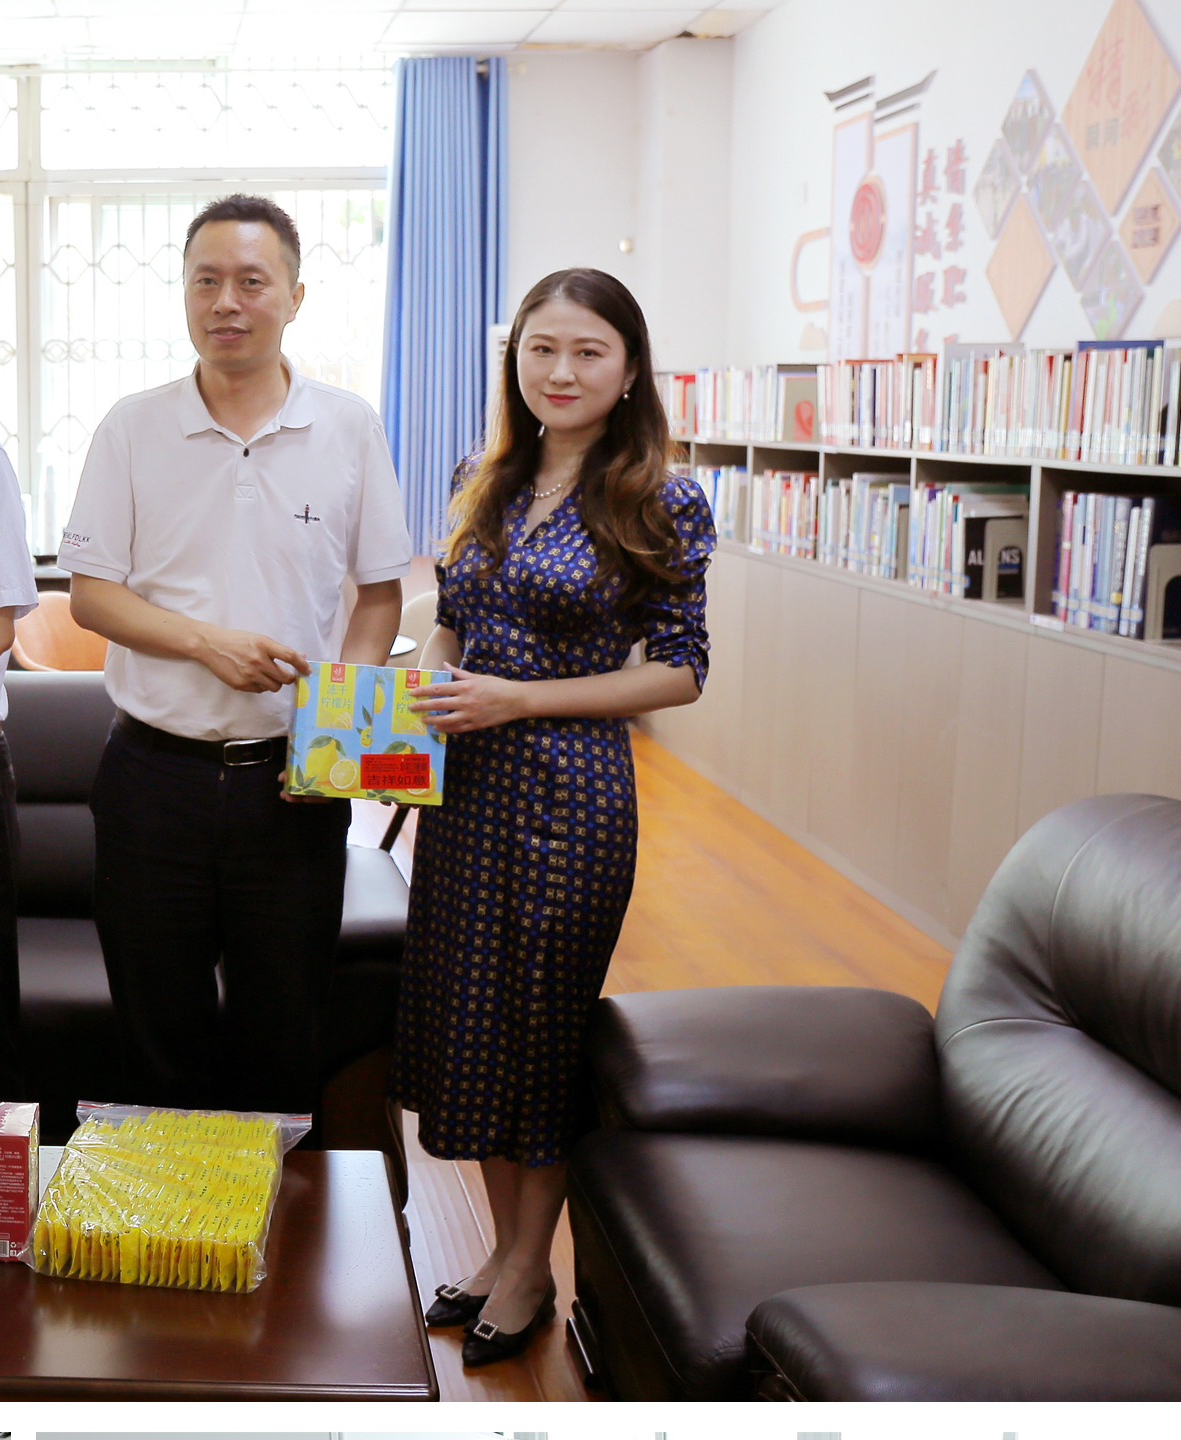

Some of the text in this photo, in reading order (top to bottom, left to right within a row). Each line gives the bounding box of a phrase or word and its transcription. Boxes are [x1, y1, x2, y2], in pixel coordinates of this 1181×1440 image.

[326, 684, 348, 696] 冻干
[320, 697, 352, 710] 柠檬片
[367, 774, 427, 786] 吉祥如意
